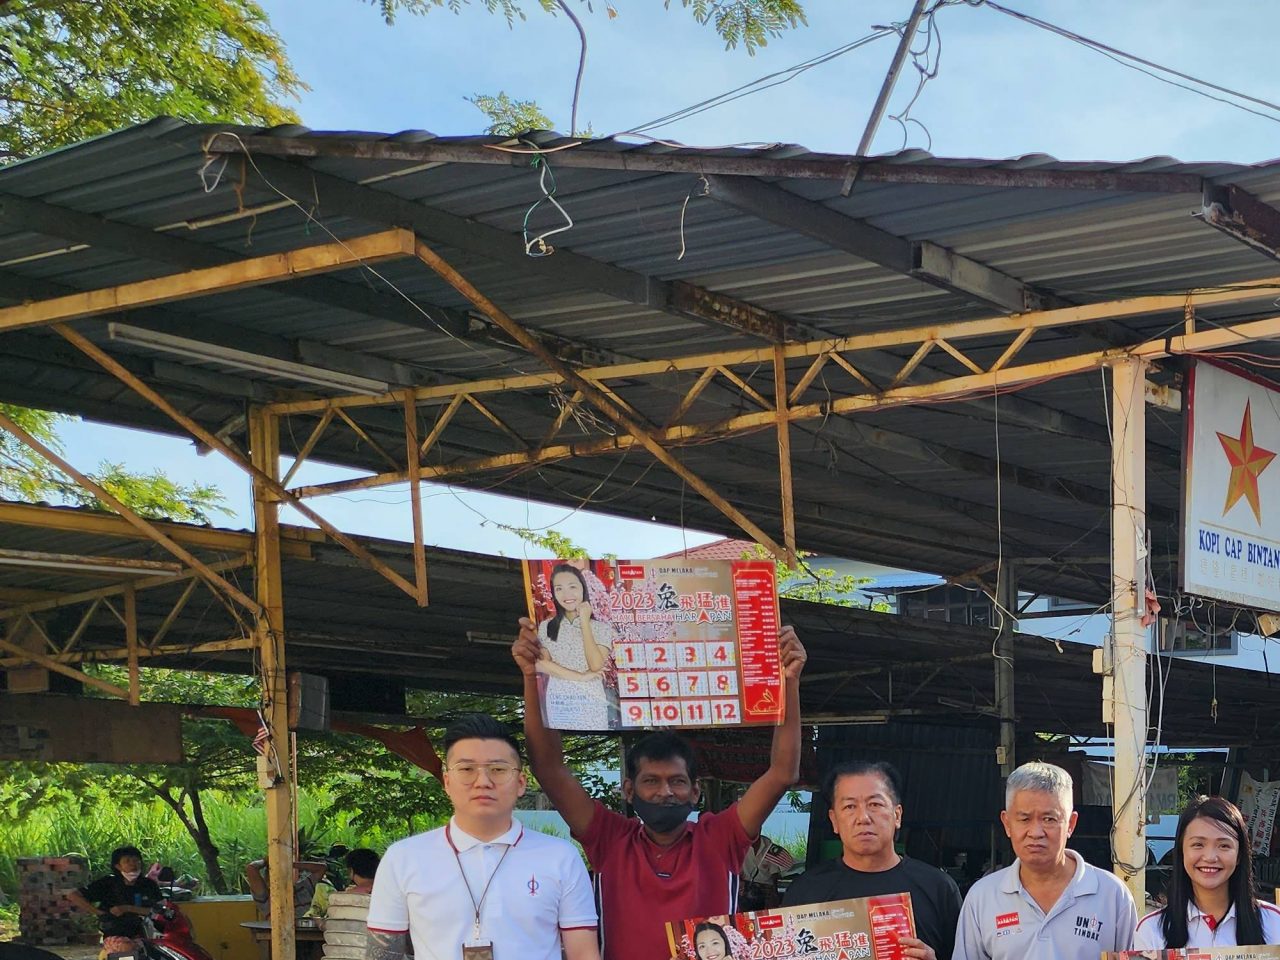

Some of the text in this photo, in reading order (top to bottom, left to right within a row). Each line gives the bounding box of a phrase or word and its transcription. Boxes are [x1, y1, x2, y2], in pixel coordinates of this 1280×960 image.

[1199, 529, 1219, 554] KOPI
[1225, 536, 1242, 560] CAP
[611, 593, 654, 610] 2023
[624, 647, 727, 663] 1 2 3 4
[625, 674, 729, 692] 5 6 7 8
[627, 704, 736, 720] 9 10 11 12
[1074, 927, 1100, 942] TINDAK
[751, 939, 795, 959] 2023
